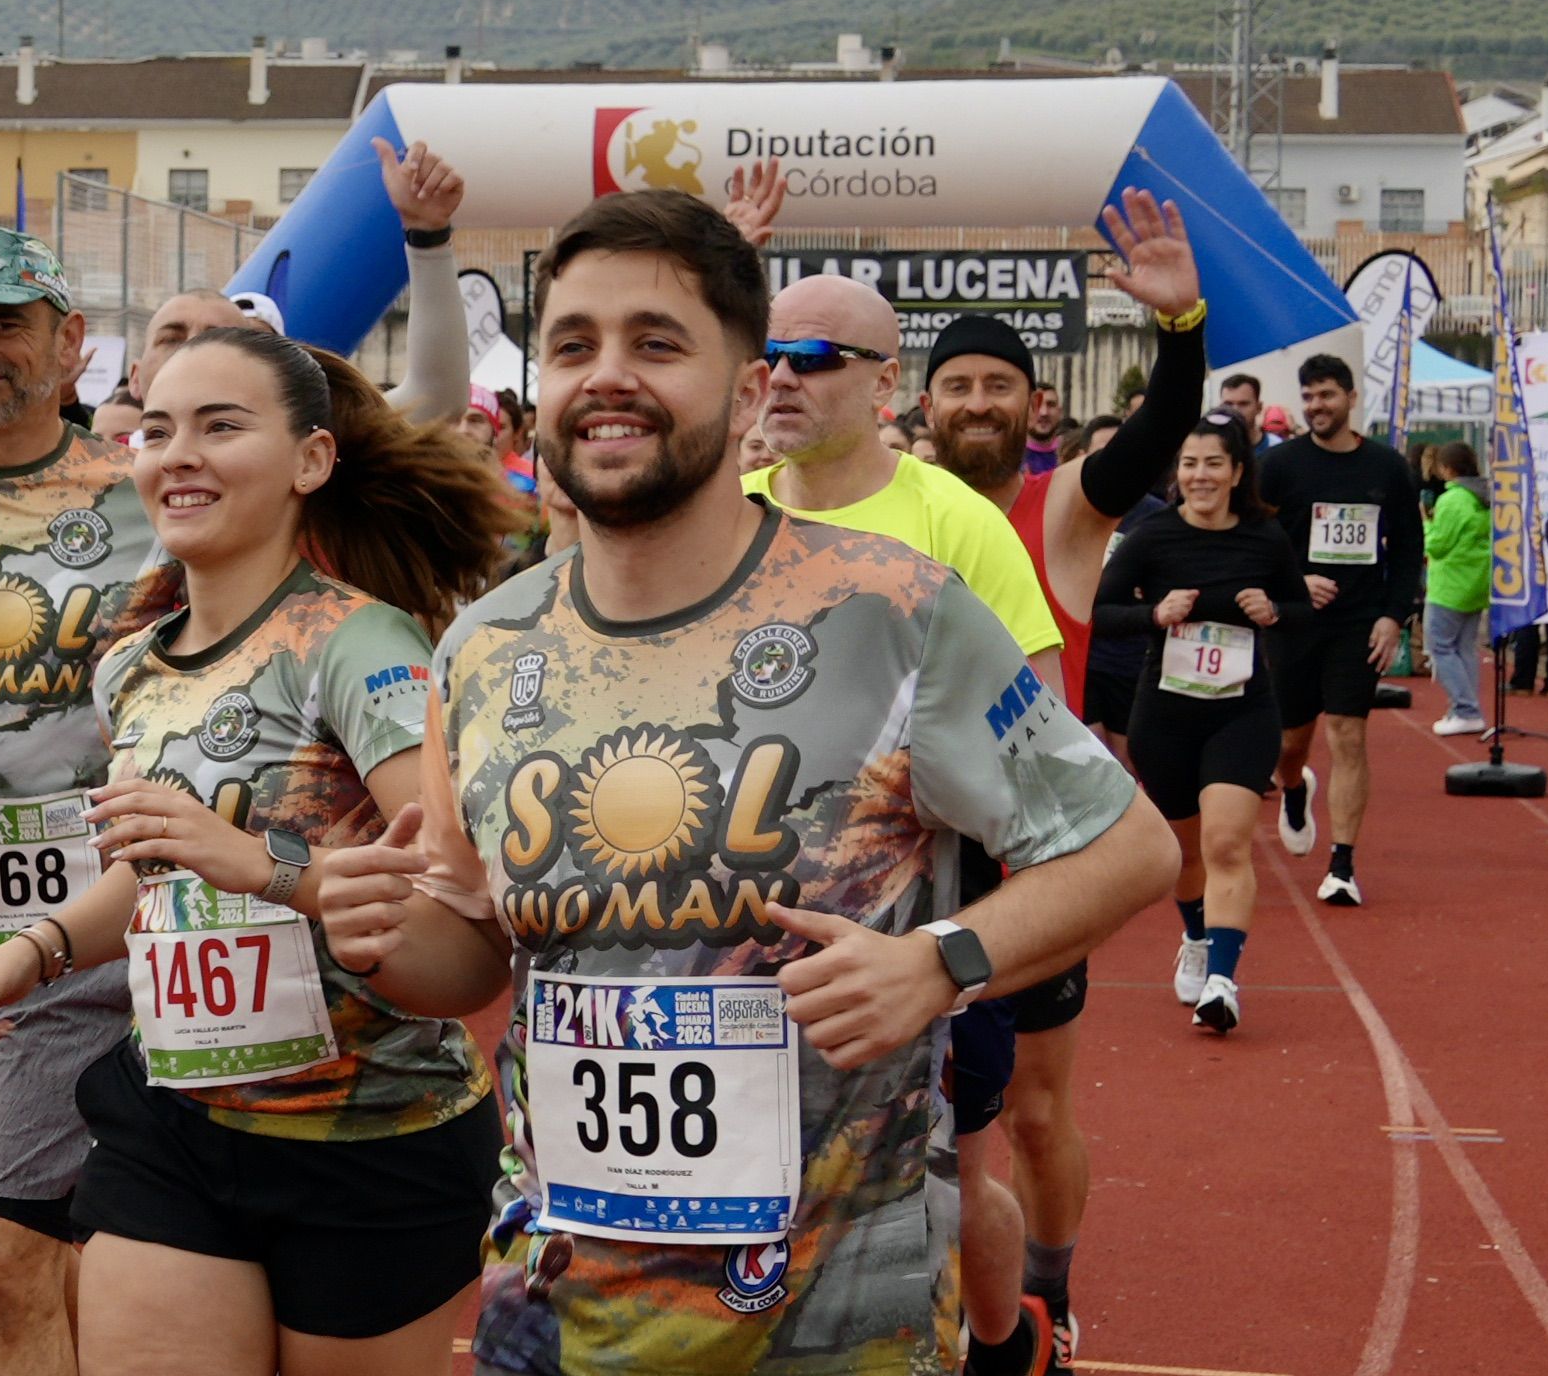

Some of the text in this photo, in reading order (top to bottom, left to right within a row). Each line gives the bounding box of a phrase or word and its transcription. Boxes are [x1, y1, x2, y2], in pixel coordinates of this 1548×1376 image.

[727, 127, 935, 158] Diputación
[784, 167, 937, 197] Córdoba
[896, 258, 1080, 299] LUCENA
[1322, 523, 1368, 545] 1338
[1493, 470, 1525, 596] CASH
[736, 627, 809, 659] CAMALEONES
[1194, 646, 1222, 675] 19
[735, 666, 805, 698] TRAIL RUNNING
[985, 664, 1043, 741] MR
[217, 908, 244, 925] 2026
[505, 878, 783, 936] WOMAN
[145, 934, 271, 1019] 1467
[556, 984, 624, 1047] 21K
[675, 1001, 710, 1013] LUCENA
[718, 998, 769, 1010] carreras
[719, 1006, 780, 1022] populares
[676, 1025, 713, 1045] 2026
[572, 1058, 718, 1158] 358
